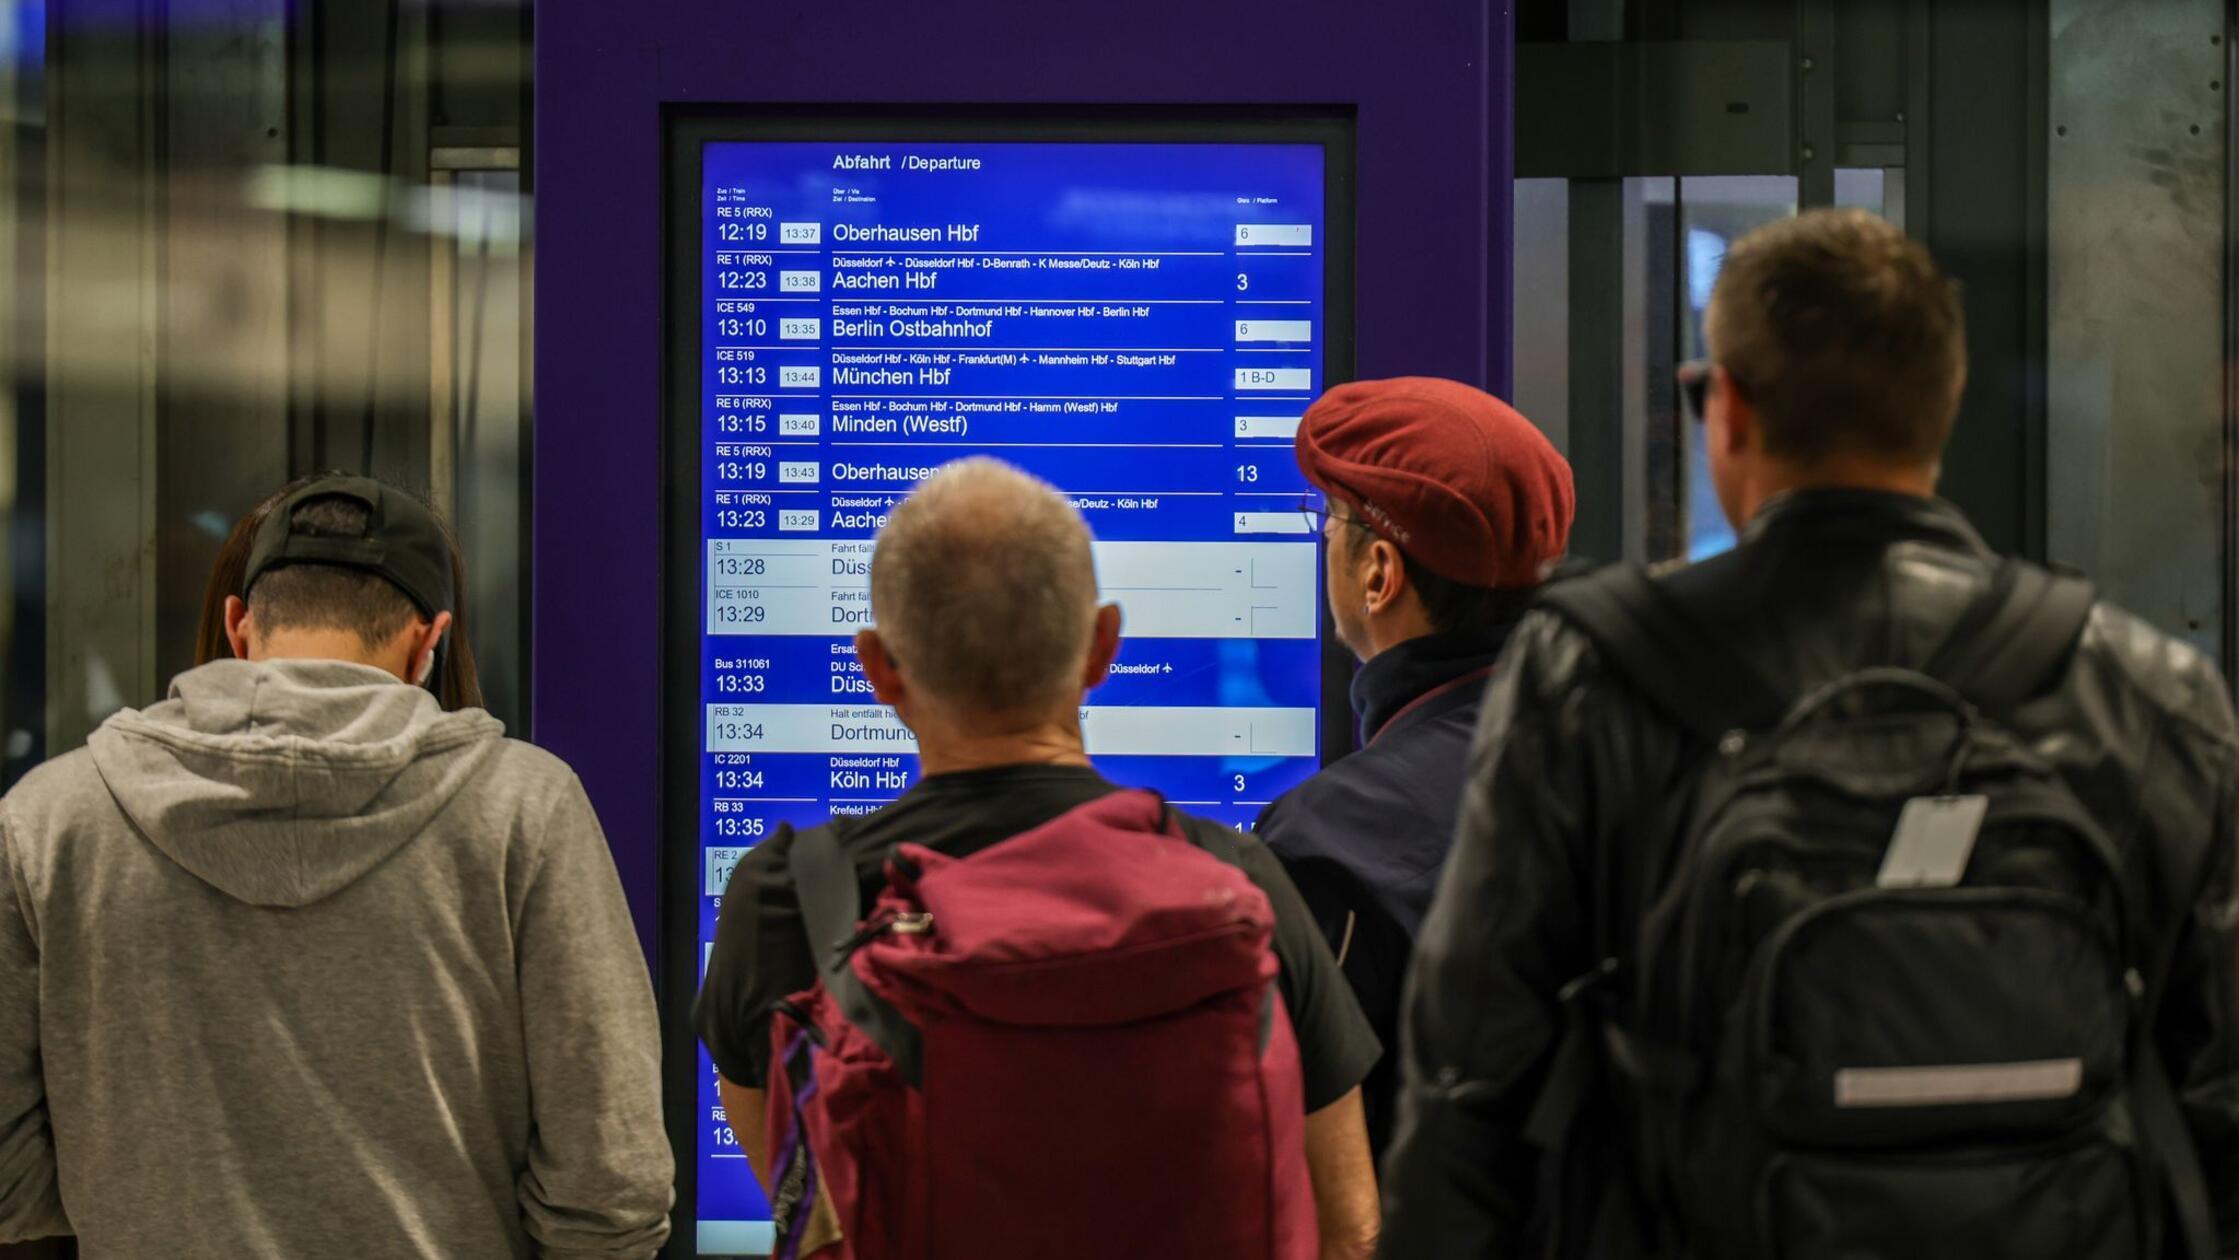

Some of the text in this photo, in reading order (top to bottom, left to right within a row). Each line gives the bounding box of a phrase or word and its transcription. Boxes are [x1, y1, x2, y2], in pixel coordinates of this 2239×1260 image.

[832, 154, 891, 169] Abfahrt
[717, 206, 773, 219] RE 5 (RRX)
[718, 223, 767, 241] 12:19
[785, 228, 816, 239] 13:37
[833, 223, 980, 242] Oberhausen Hbf
[1240, 227, 1249, 240] 6
[716, 254, 772, 266] RE 1 (RRX)
[832, 257, 1160, 269] Düsseldorf Düsseldorf Hbf D-Benrath K Messe/Deutz Köln Hbf
[718, 271, 767, 289] 12:23
[785, 276, 816, 287] 13:38
[832, 271, 938, 289] Aachen Hbf
[1236, 273, 1248, 291] 3
[716, 302, 755, 313] ICE 549
[832, 305, 1150, 317] Essen Hbf Bochum Hbf Dortmund Hbf Hannover Hbf Berlin Hbf
[718, 318, 767, 336] 13:10
[785, 323, 816, 335] 13:35
[833, 319, 993, 337] Berlin Ostbahnhof
[1239, 323, 1248, 336] 6
[716, 350, 755, 361] ICE 519
[832, 353, 1176, 367] Düsseldorf Hbf Köln Hbf Frankfurt(M) Mannheim Hbf Stuttgart Hbf
[718, 366, 766, 384] 13:13
[785, 372, 815, 383] 13:44
[833, 367, 952, 385] München Hbf
[1241, 371, 1276, 384] 1 B-D
[716, 397, 772, 410] RE 6 (RRX)
[832, 400, 1119, 414] Essen Hbf Bochum Hbf Dortmund Hbf Hamm (Westf) Hbf
[717, 414, 766, 432] 13:15
[785, 419, 816, 431] 13:40
[832, 414, 968, 437] Minden (Westf)
[1239, 419, 1248, 432] 3
[716, 445, 772, 458] RE 5 (RRX)
[717, 462, 766, 480] 13:19
[785, 467, 815, 478] 13:43
[1237, 464, 1258, 482] 13
[715, 493, 772, 506] RE 1 (RRX)
[831, 496, 883, 508] Düsseldorf
[1117, 498, 1139, 509] Köln
[1141, 498, 1159, 509] Hbf
[717, 510, 766, 528] 13:23
[784, 515, 815, 526] 13:29
[831, 511, 889, 529] Aache
[1238, 515, 1246, 527] 4
[715, 541, 731, 552] S 1
[831, 543, 857, 554] Fahrt
[717, 558, 765, 575] 13:28
[715, 589, 760, 600] ICE 1010
[831, 591, 857, 601] Fahrt
[717, 605, 765, 623] 13:29
[831, 606, 872, 623] Dort
[714, 658, 770, 669] Bus 311061
[830, 661, 847, 672] DU
[1109, 663, 1161, 675] Düsseldorf
[716, 674, 765, 693] 13:33
[715, 706, 745, 717] RB 32
[830, 708, 850, 719] Halt
[851, 708, 884, 719] entfällt
[716, 723, 764, 740] 13:34
[714, 753, 751, 765] IC 2201
[830, 757, 900, 768] Düsseldorf Hbf
[715, 770, 764, 789] 13:34
[830, 770, 908, 789] Köln Hbf
[1234, 774, 1245, 792] 3
[714, 801, 744, 813] RB 33
[829, 805, 864, 816] Krefeld
[715, 818, 764, 836] 13:35
[713, 850, 739, 860] RE 2
